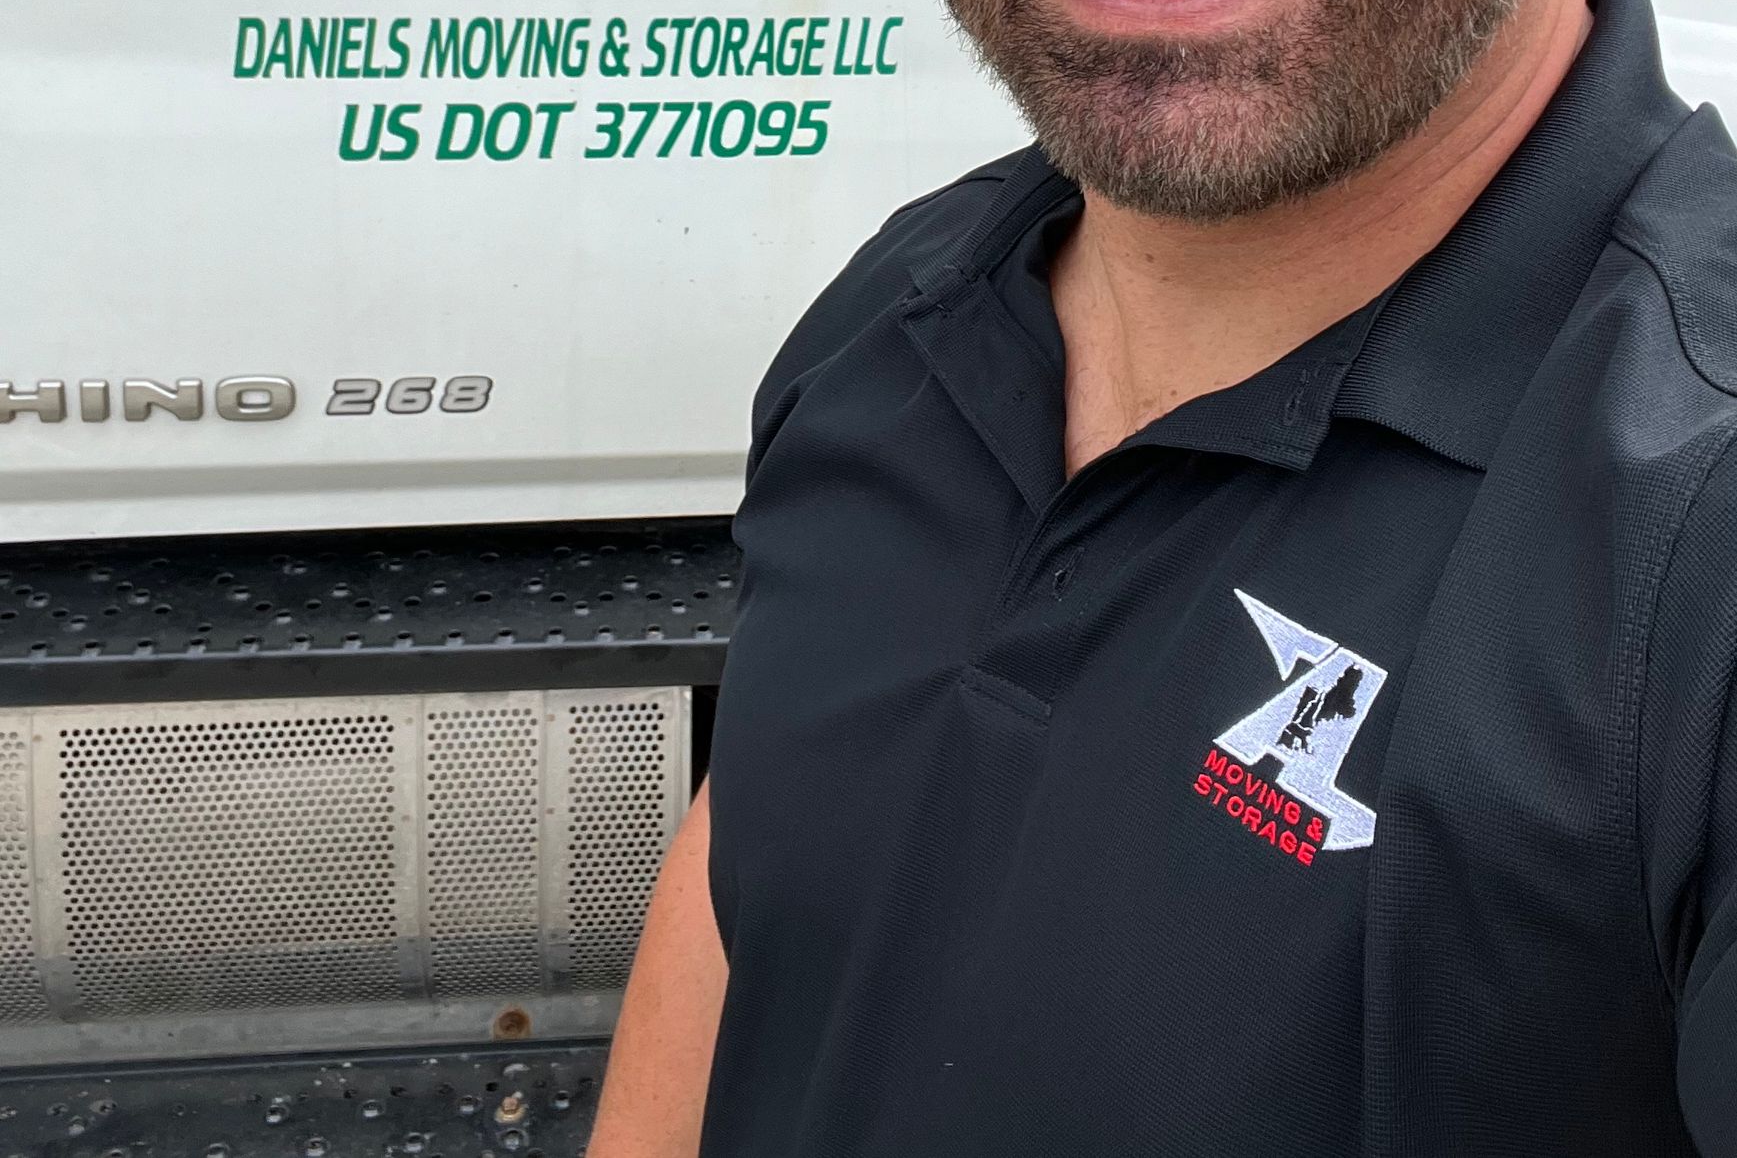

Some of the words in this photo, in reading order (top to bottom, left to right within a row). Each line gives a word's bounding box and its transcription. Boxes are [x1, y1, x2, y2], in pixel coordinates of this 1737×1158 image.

[233, 17, 410, 79] DANIELS
[420, 17, 591, 80] MOVING
[598, 17, 630, 78] &
[640, 16, 830, 79] STORAGE
[833, 16, 904, 76] LLC
[338, 104, 421, 162] US
[435, 102, 576, 162] DOT
[583, 99, 832, 160] 3771095
[0, 375, 297, 424] HINO
[325, 375, 494, 416] 268
[1193, 773, 1317, 867] STORAGE
[1203, 749, 1302, 826] MOVING
[1305, 816, 1324, 843] &
